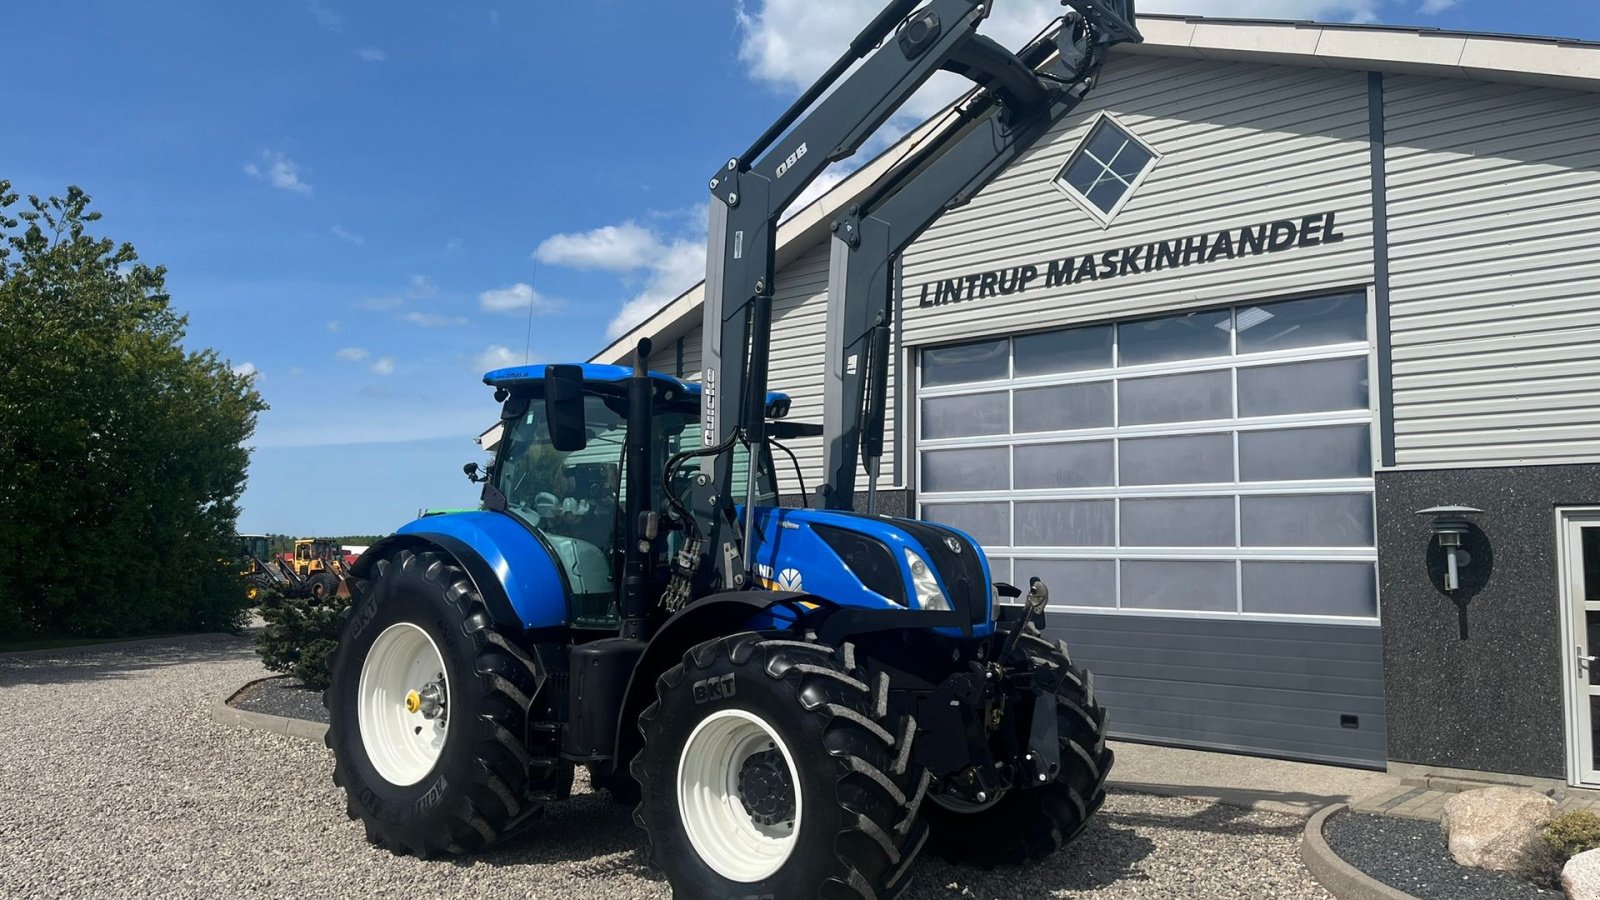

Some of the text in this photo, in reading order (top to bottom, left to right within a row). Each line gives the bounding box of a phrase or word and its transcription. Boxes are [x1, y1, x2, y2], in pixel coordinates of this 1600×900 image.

[919, 211, 1344, 309] LINTRUP MASKINHANDEL
[692, 671, 737, 705] BKT
